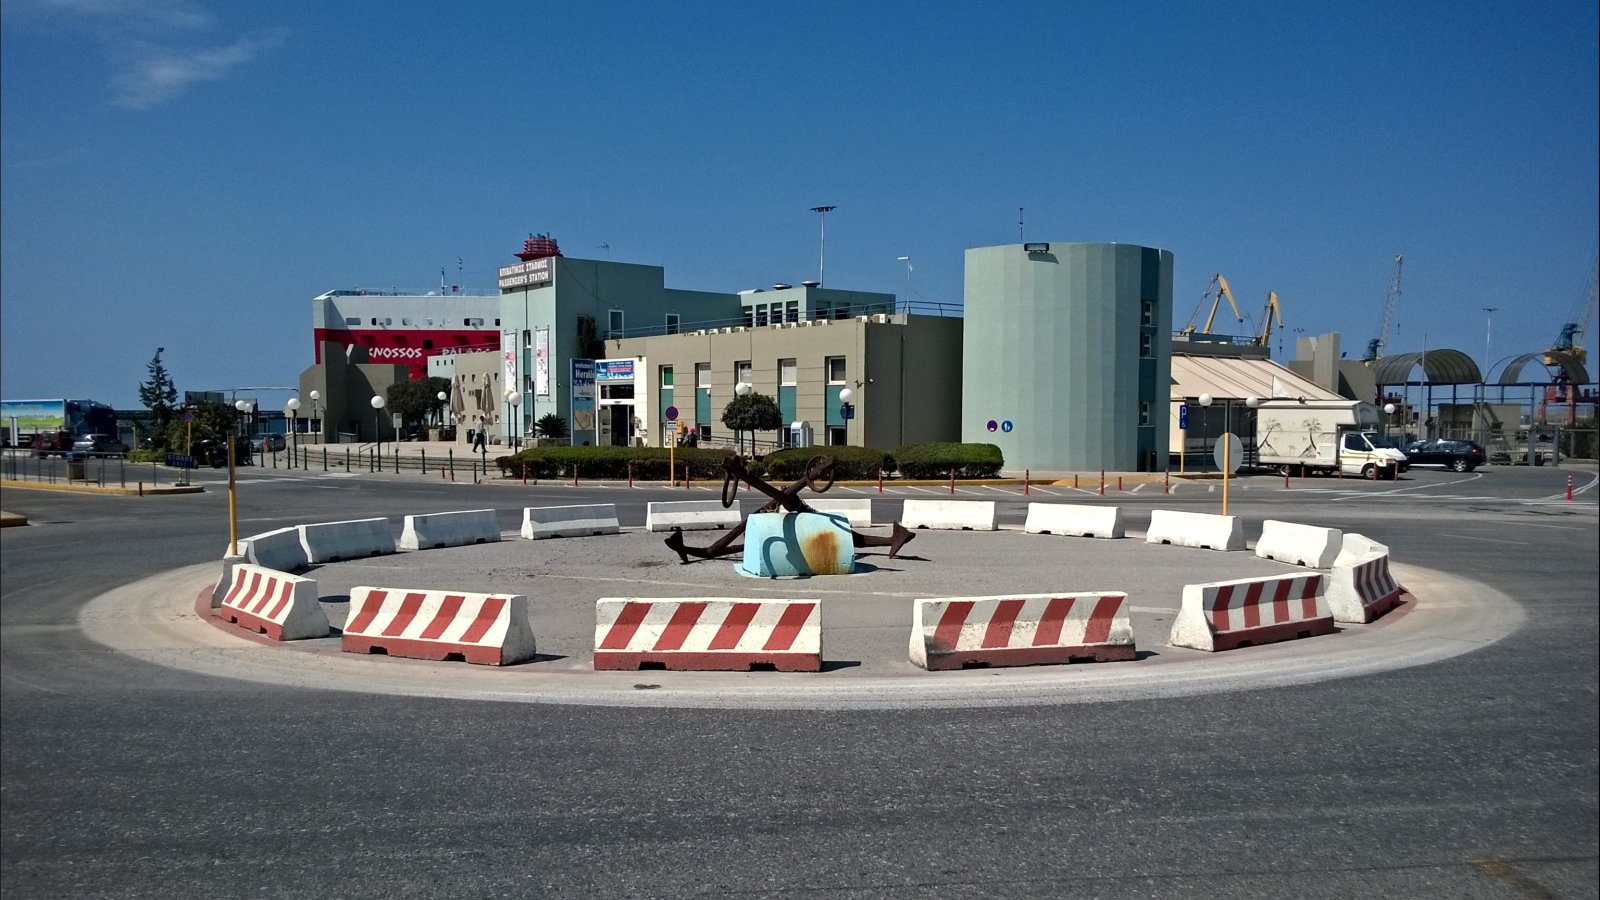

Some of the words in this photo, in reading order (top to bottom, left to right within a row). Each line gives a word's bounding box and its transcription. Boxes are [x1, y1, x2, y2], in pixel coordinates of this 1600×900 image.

[499, 274, 528, 288] PASSENGER'S
[529, 271, 548, 282] STATION
[1181, 406, 1187, 419] P
